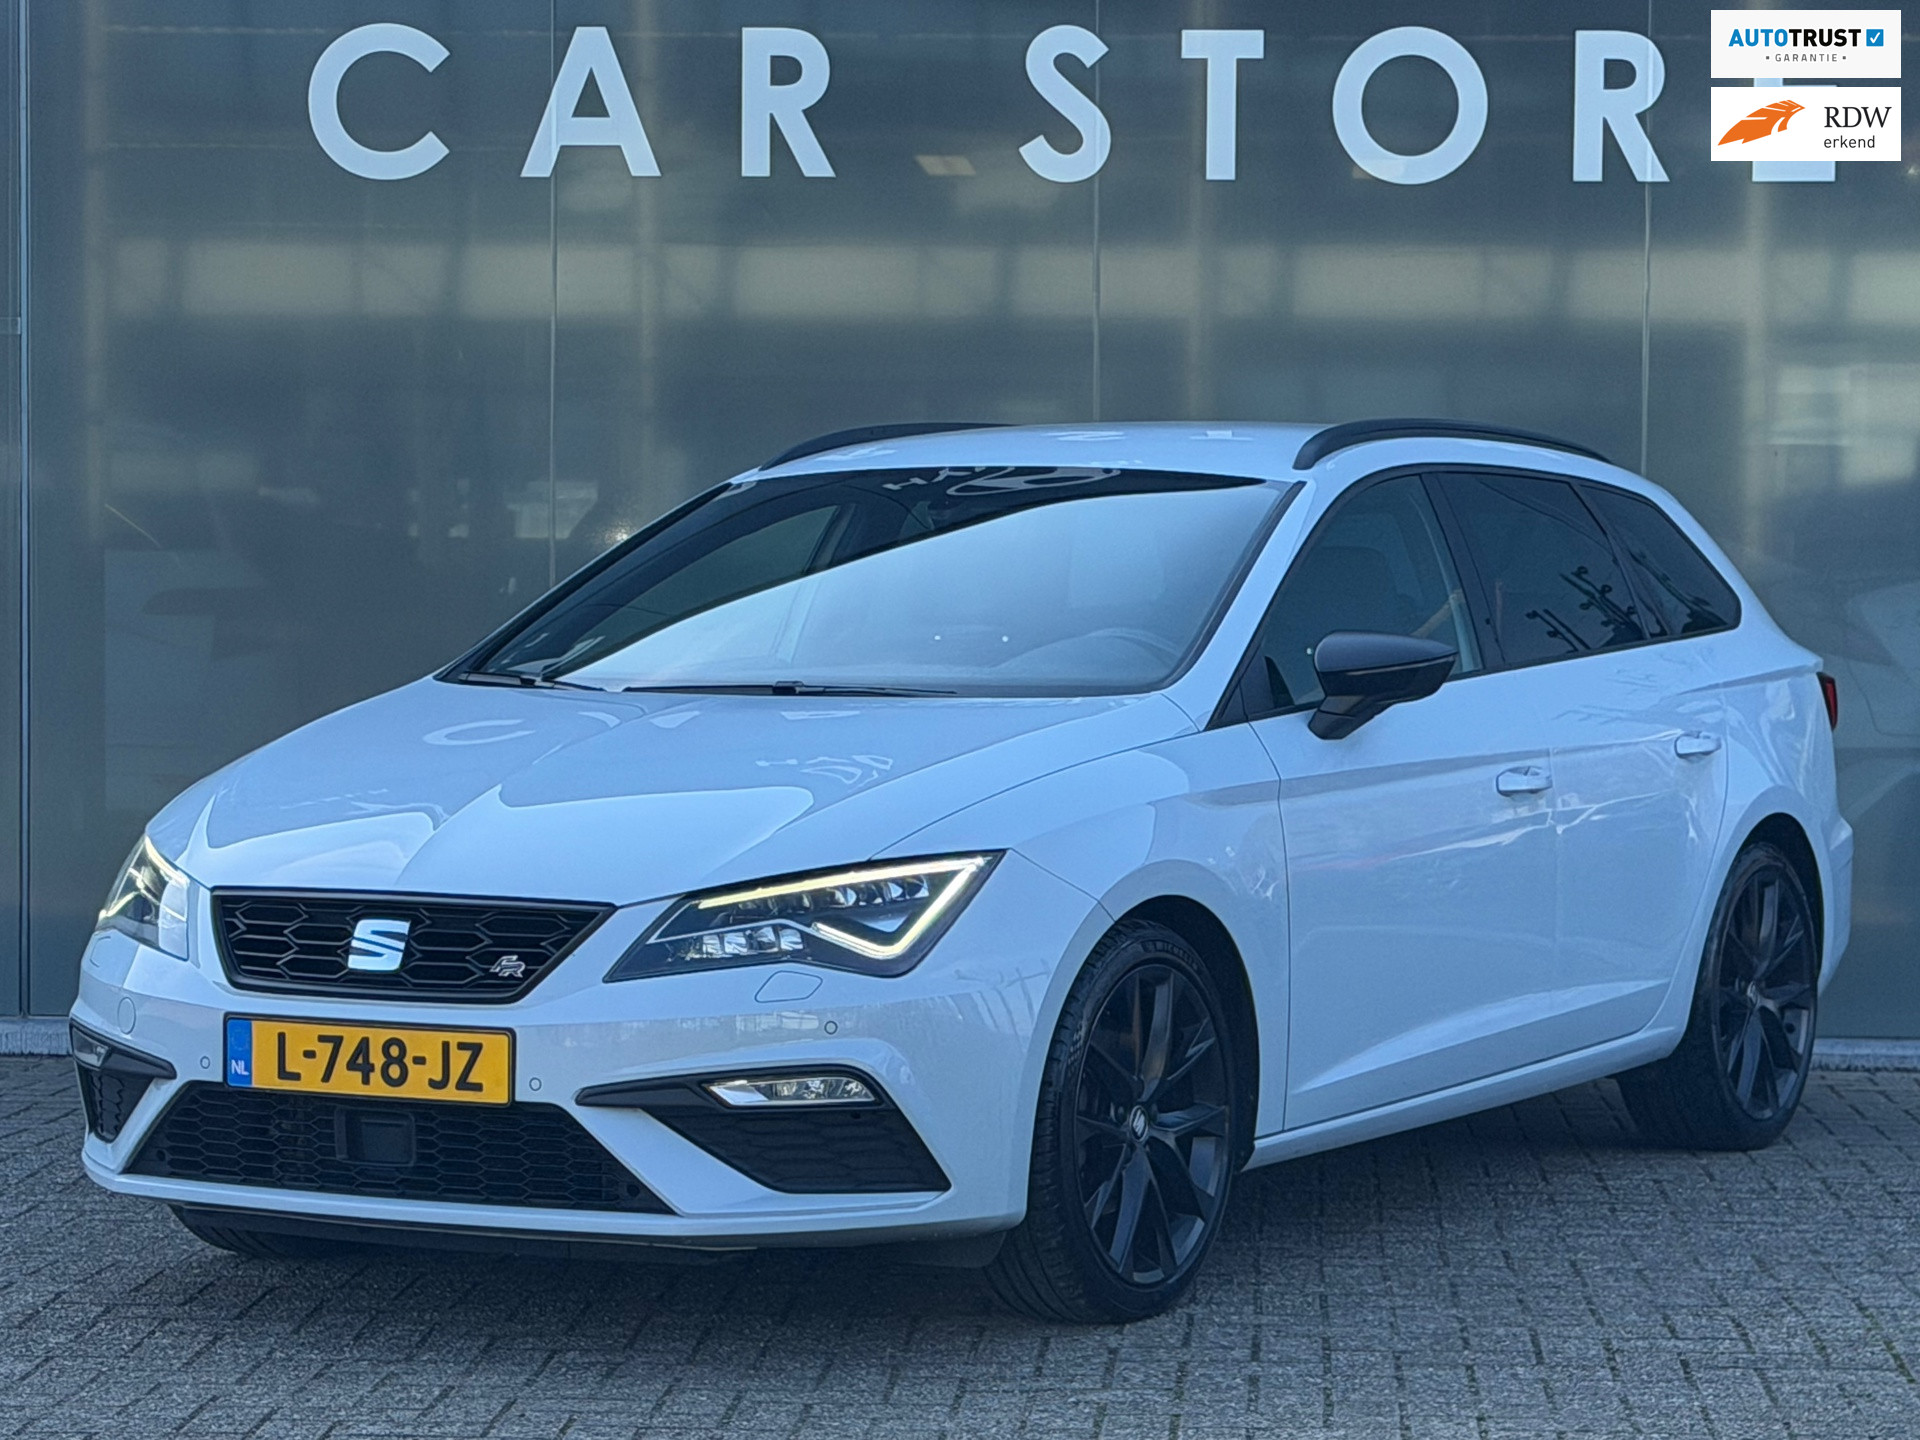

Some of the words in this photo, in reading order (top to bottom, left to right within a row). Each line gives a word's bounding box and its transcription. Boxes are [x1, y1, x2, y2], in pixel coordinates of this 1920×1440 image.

[307, 22, 837, 179] CAR
[230, 1058, 250, 1077] NL
[276, 1031, 484, 1093] L-748-JZ
